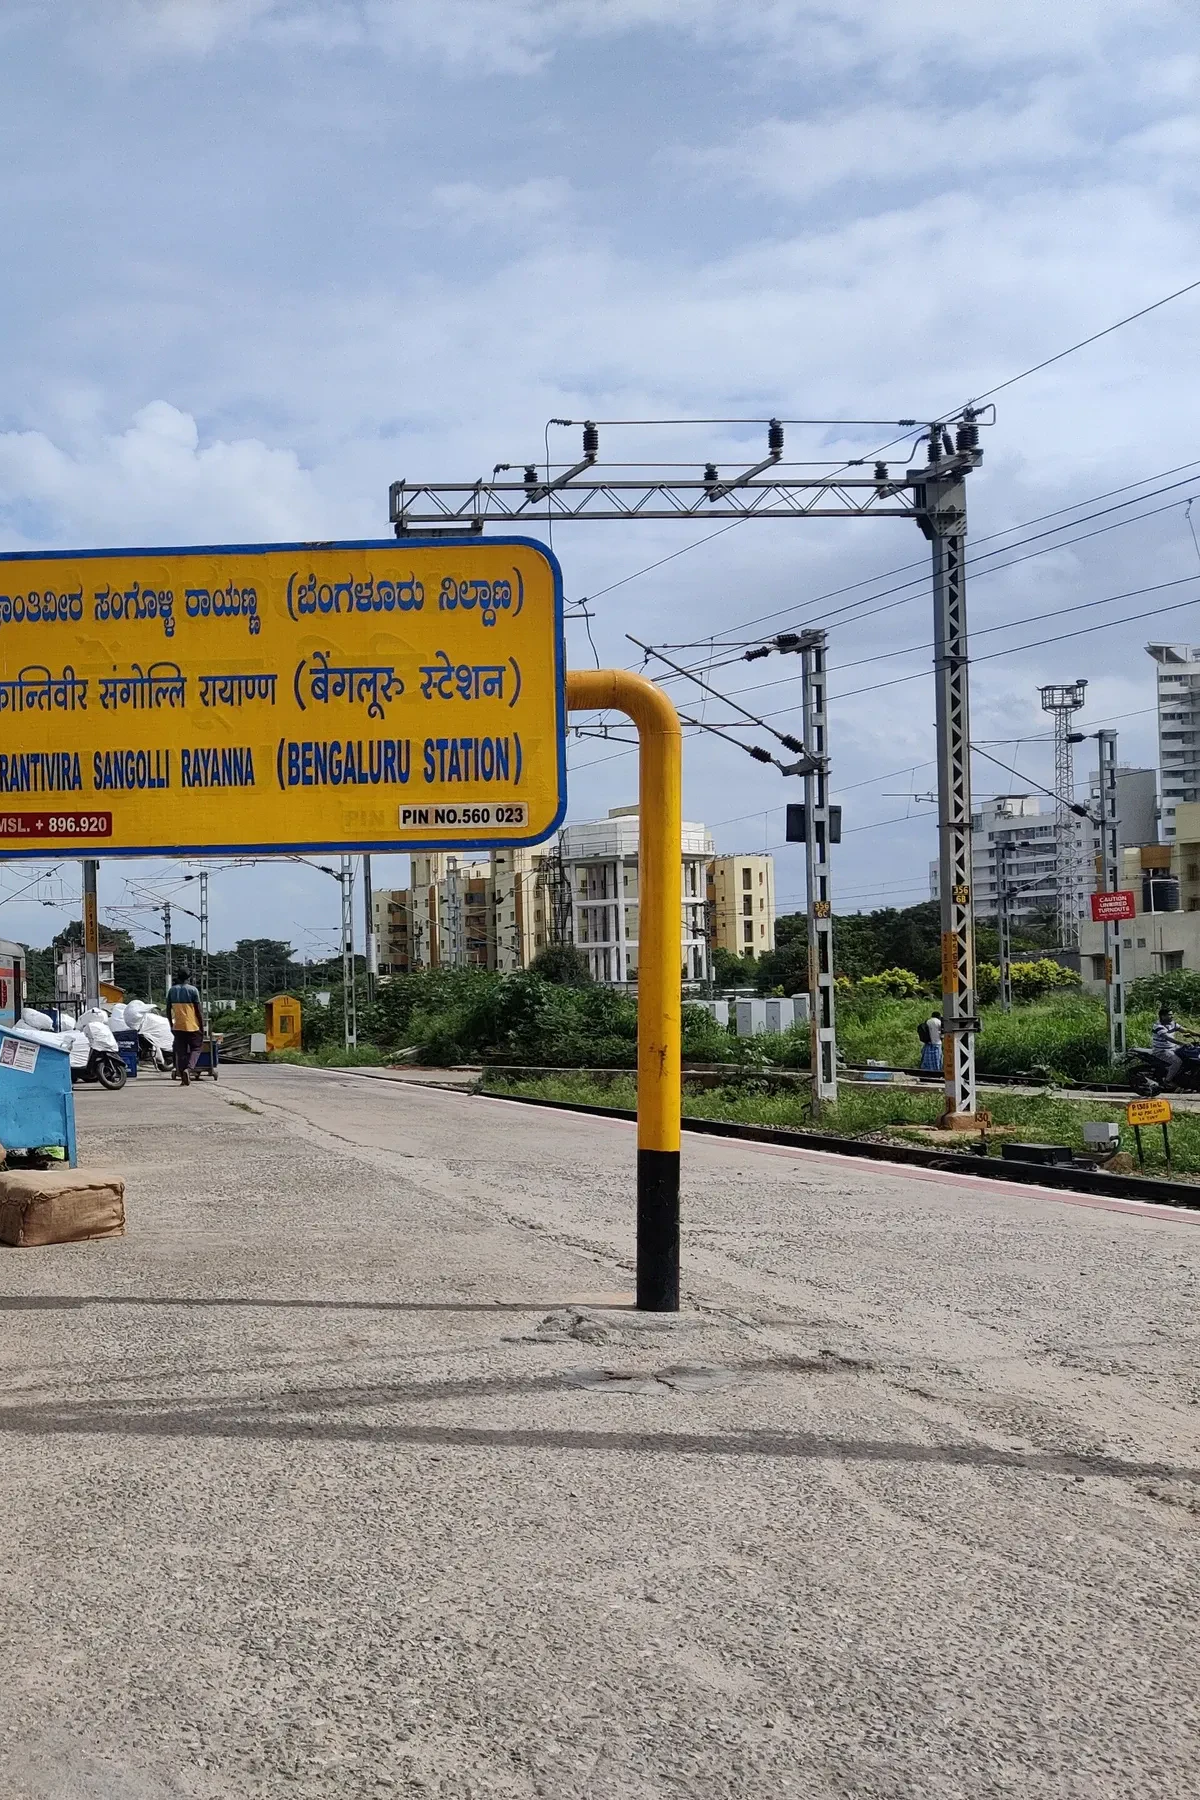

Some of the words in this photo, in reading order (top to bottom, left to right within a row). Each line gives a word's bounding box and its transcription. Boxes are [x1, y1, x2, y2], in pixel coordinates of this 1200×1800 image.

[94, 580, 176, 638] ಸಂಗೊಳ್ಳಿ
[185, 578, 261, 635] ರಾಯಣ್ಣ
[286, 571, 425, 622] (ಬೆಂಗಳೂರು
[438, 566, 524, 627] ನಿಲ್ದಾಣ)
[98, 661, 188, 710] संगोल्लि
[294, 650, 405, 720] (बेंगलूरु
[419, 650, 522, 708] स्टेशन)
[93, 749, 170, 790] SANGOLLI
[181, 747, 256, 788] RAYANNA
[276, 737, 411, 790] (BENGALURU
[423, 731, 523, 786] STATION)
[35, 820, 44, 831] +
[48, 816, 108, 833] 896.920
[402, 809, 429, 825] PIN
[434, 808, 490, 824] NO.560
[495, 807, 524, 823] 023
[953, 886, 969, 894] 356
[814, 902, 830, 910] 356
